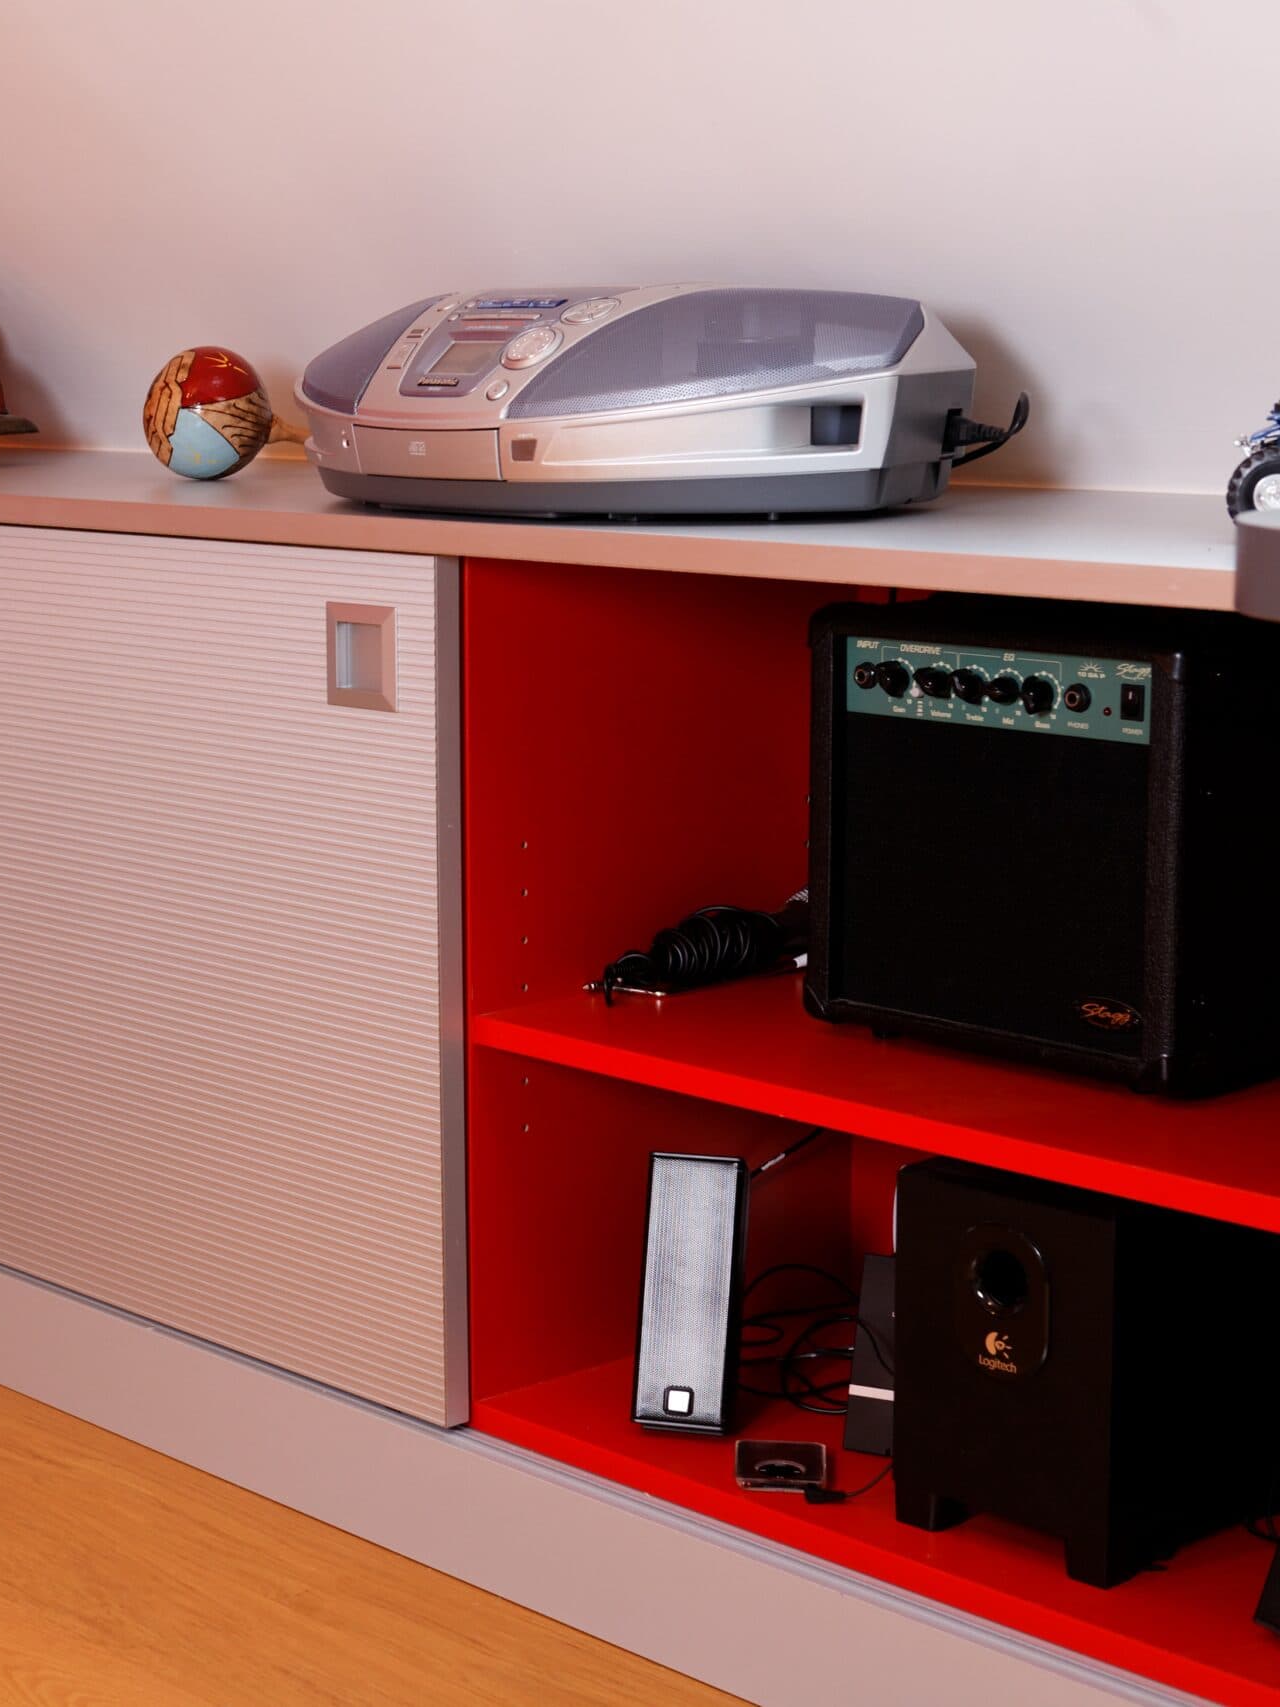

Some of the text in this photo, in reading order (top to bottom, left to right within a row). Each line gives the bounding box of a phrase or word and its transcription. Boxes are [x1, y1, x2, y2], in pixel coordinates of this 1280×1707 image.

[855, 640, 880, 649] INPUT
[899, 642, 943, 656] OVERDRIVE
[930, 708, 952, 719] Volume
[978, 1353, 1017, 1374] Logitech
